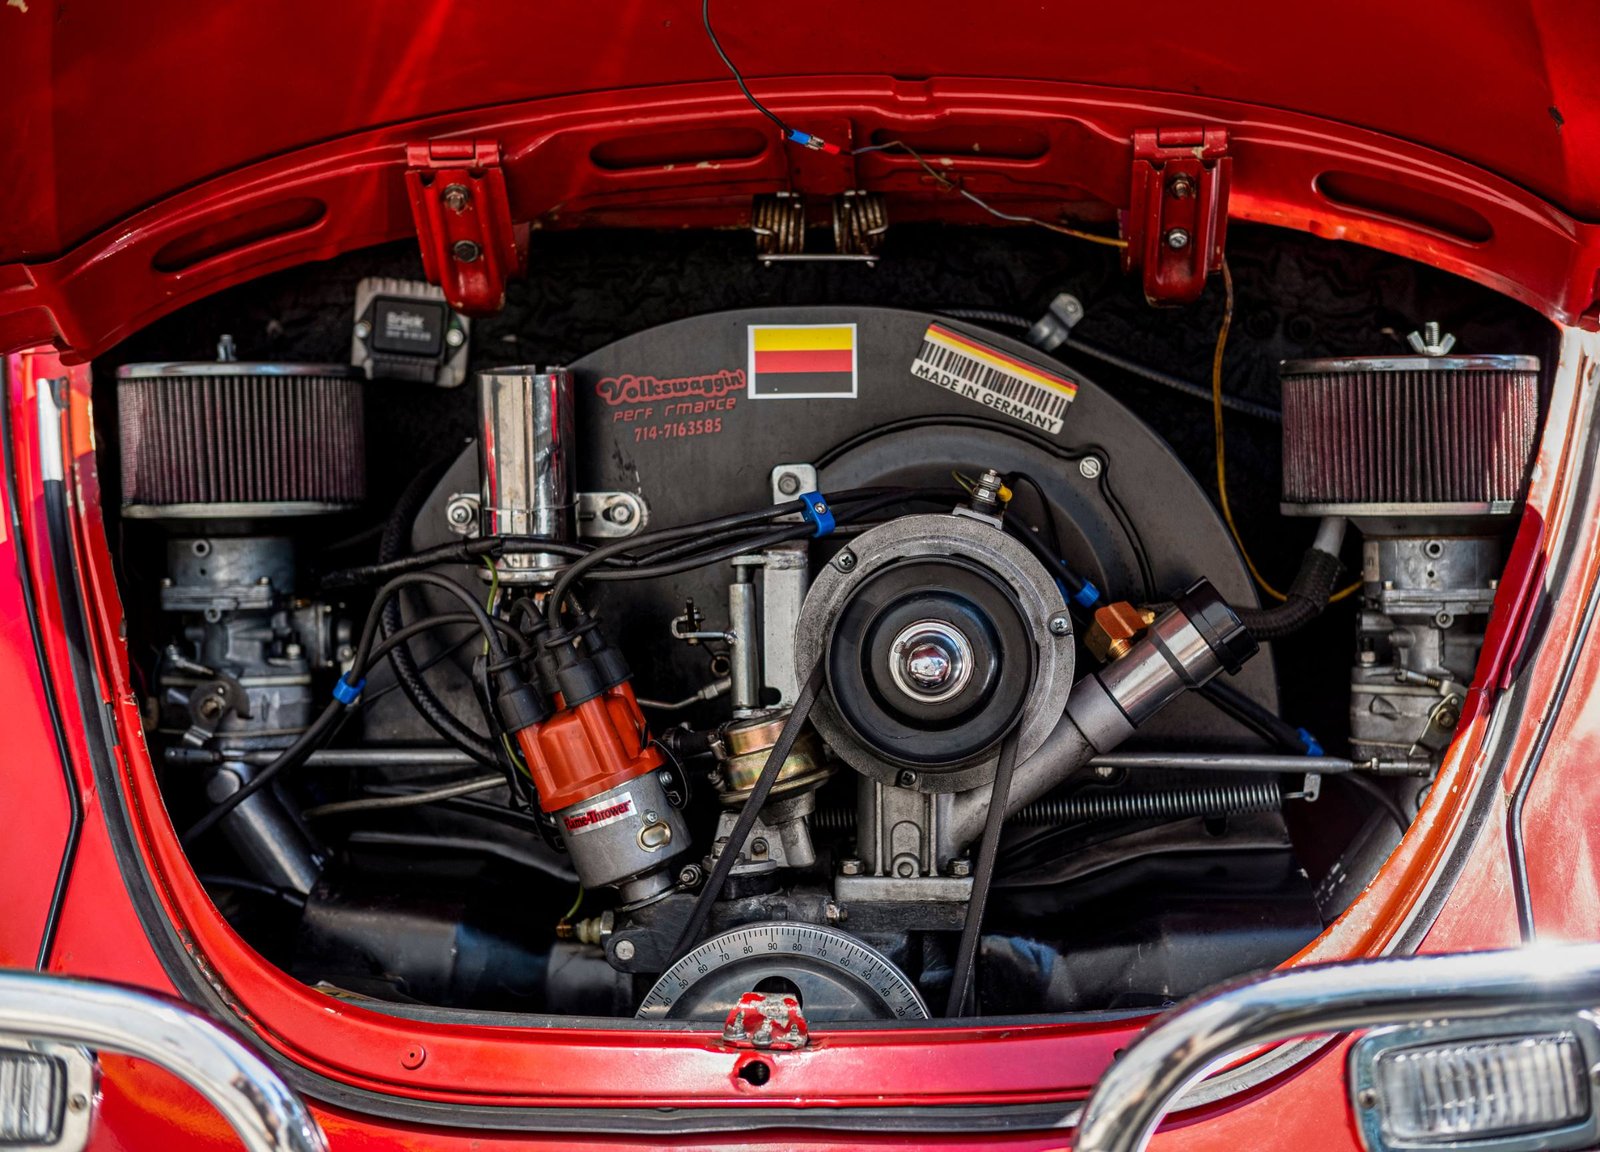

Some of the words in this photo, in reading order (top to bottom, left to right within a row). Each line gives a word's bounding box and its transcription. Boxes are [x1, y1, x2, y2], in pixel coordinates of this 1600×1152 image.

[634, 417, 722, 442] 714-7163585
[915, 364, 960, 391] MADE
[961, 383, 980, 400] IN
[982, 393, 1059, 431] GERMANY
[662, 997, 673, 1008] 40
[678, 979, 689, 990] 50
[697, 964, 709, 974] 60
[719, 953, 730, 962] 70
[743, 945, 754, 955] 80
[767, 942, 778, 951] 90
[792, 943, 803, 951] 80
[817, 948, 827, 957] 70
[839, 957, 850, 967] 60
[861, 971, 872, 981] 50
[880, 987, 891, 997] 40
[895, 1006, 906, 1017] 30
